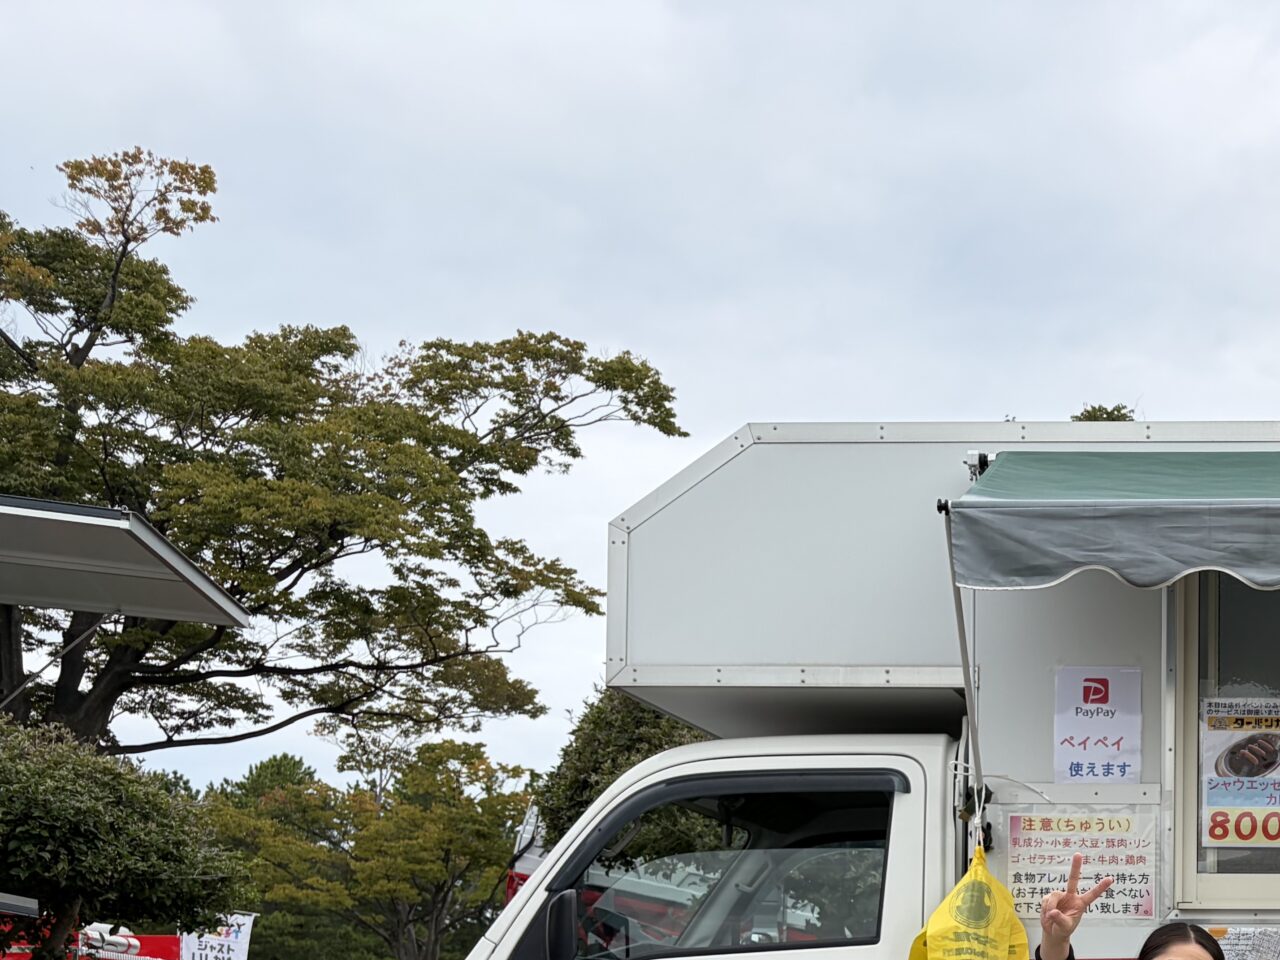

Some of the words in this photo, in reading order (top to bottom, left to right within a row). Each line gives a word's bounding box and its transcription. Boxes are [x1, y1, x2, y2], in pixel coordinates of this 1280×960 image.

[1075, 707, 1116, 719] PayPay
[1060, 736, 1124, 751] ペイペイ
[1069, 761, 1131, 777] 使えます
